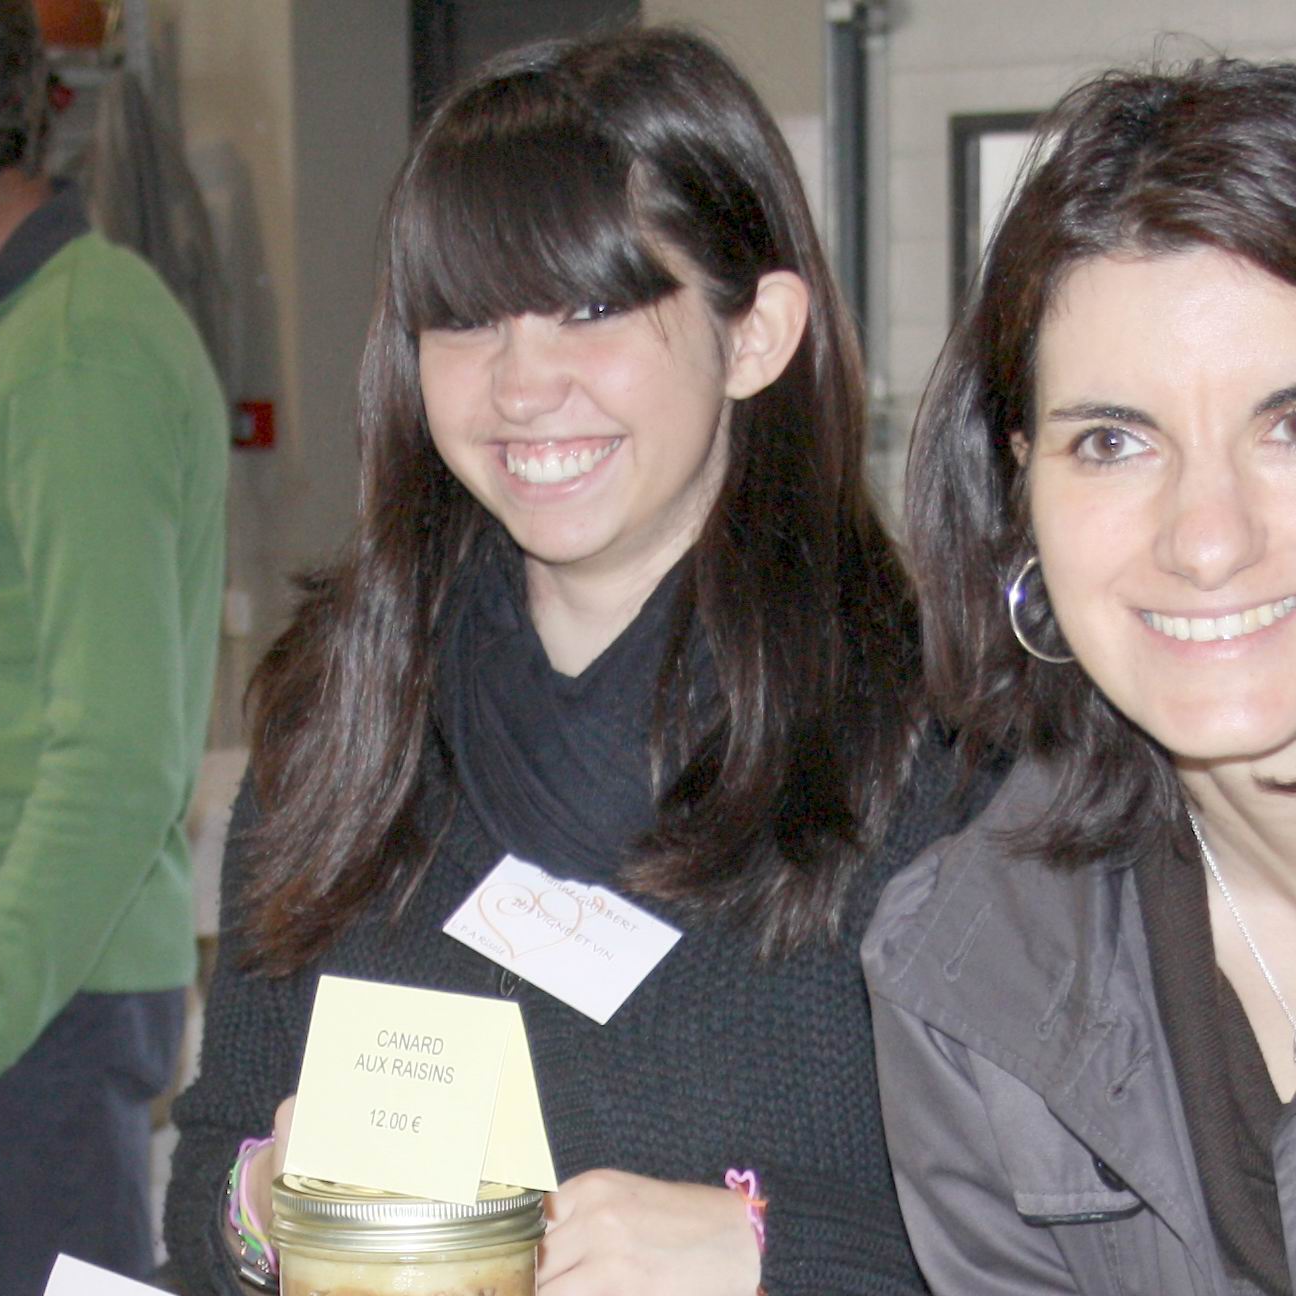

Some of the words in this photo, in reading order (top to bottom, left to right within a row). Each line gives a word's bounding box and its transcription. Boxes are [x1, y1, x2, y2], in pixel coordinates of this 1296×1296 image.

[375, 1028, 445, 1056] CANARD
[353, 1053, 389, 1075] AUX
[391, 1057, 455, 1085] RAISINS
[369, 1108, 408, 1132] 12.00
[411, 1115, 422, 1134] €
